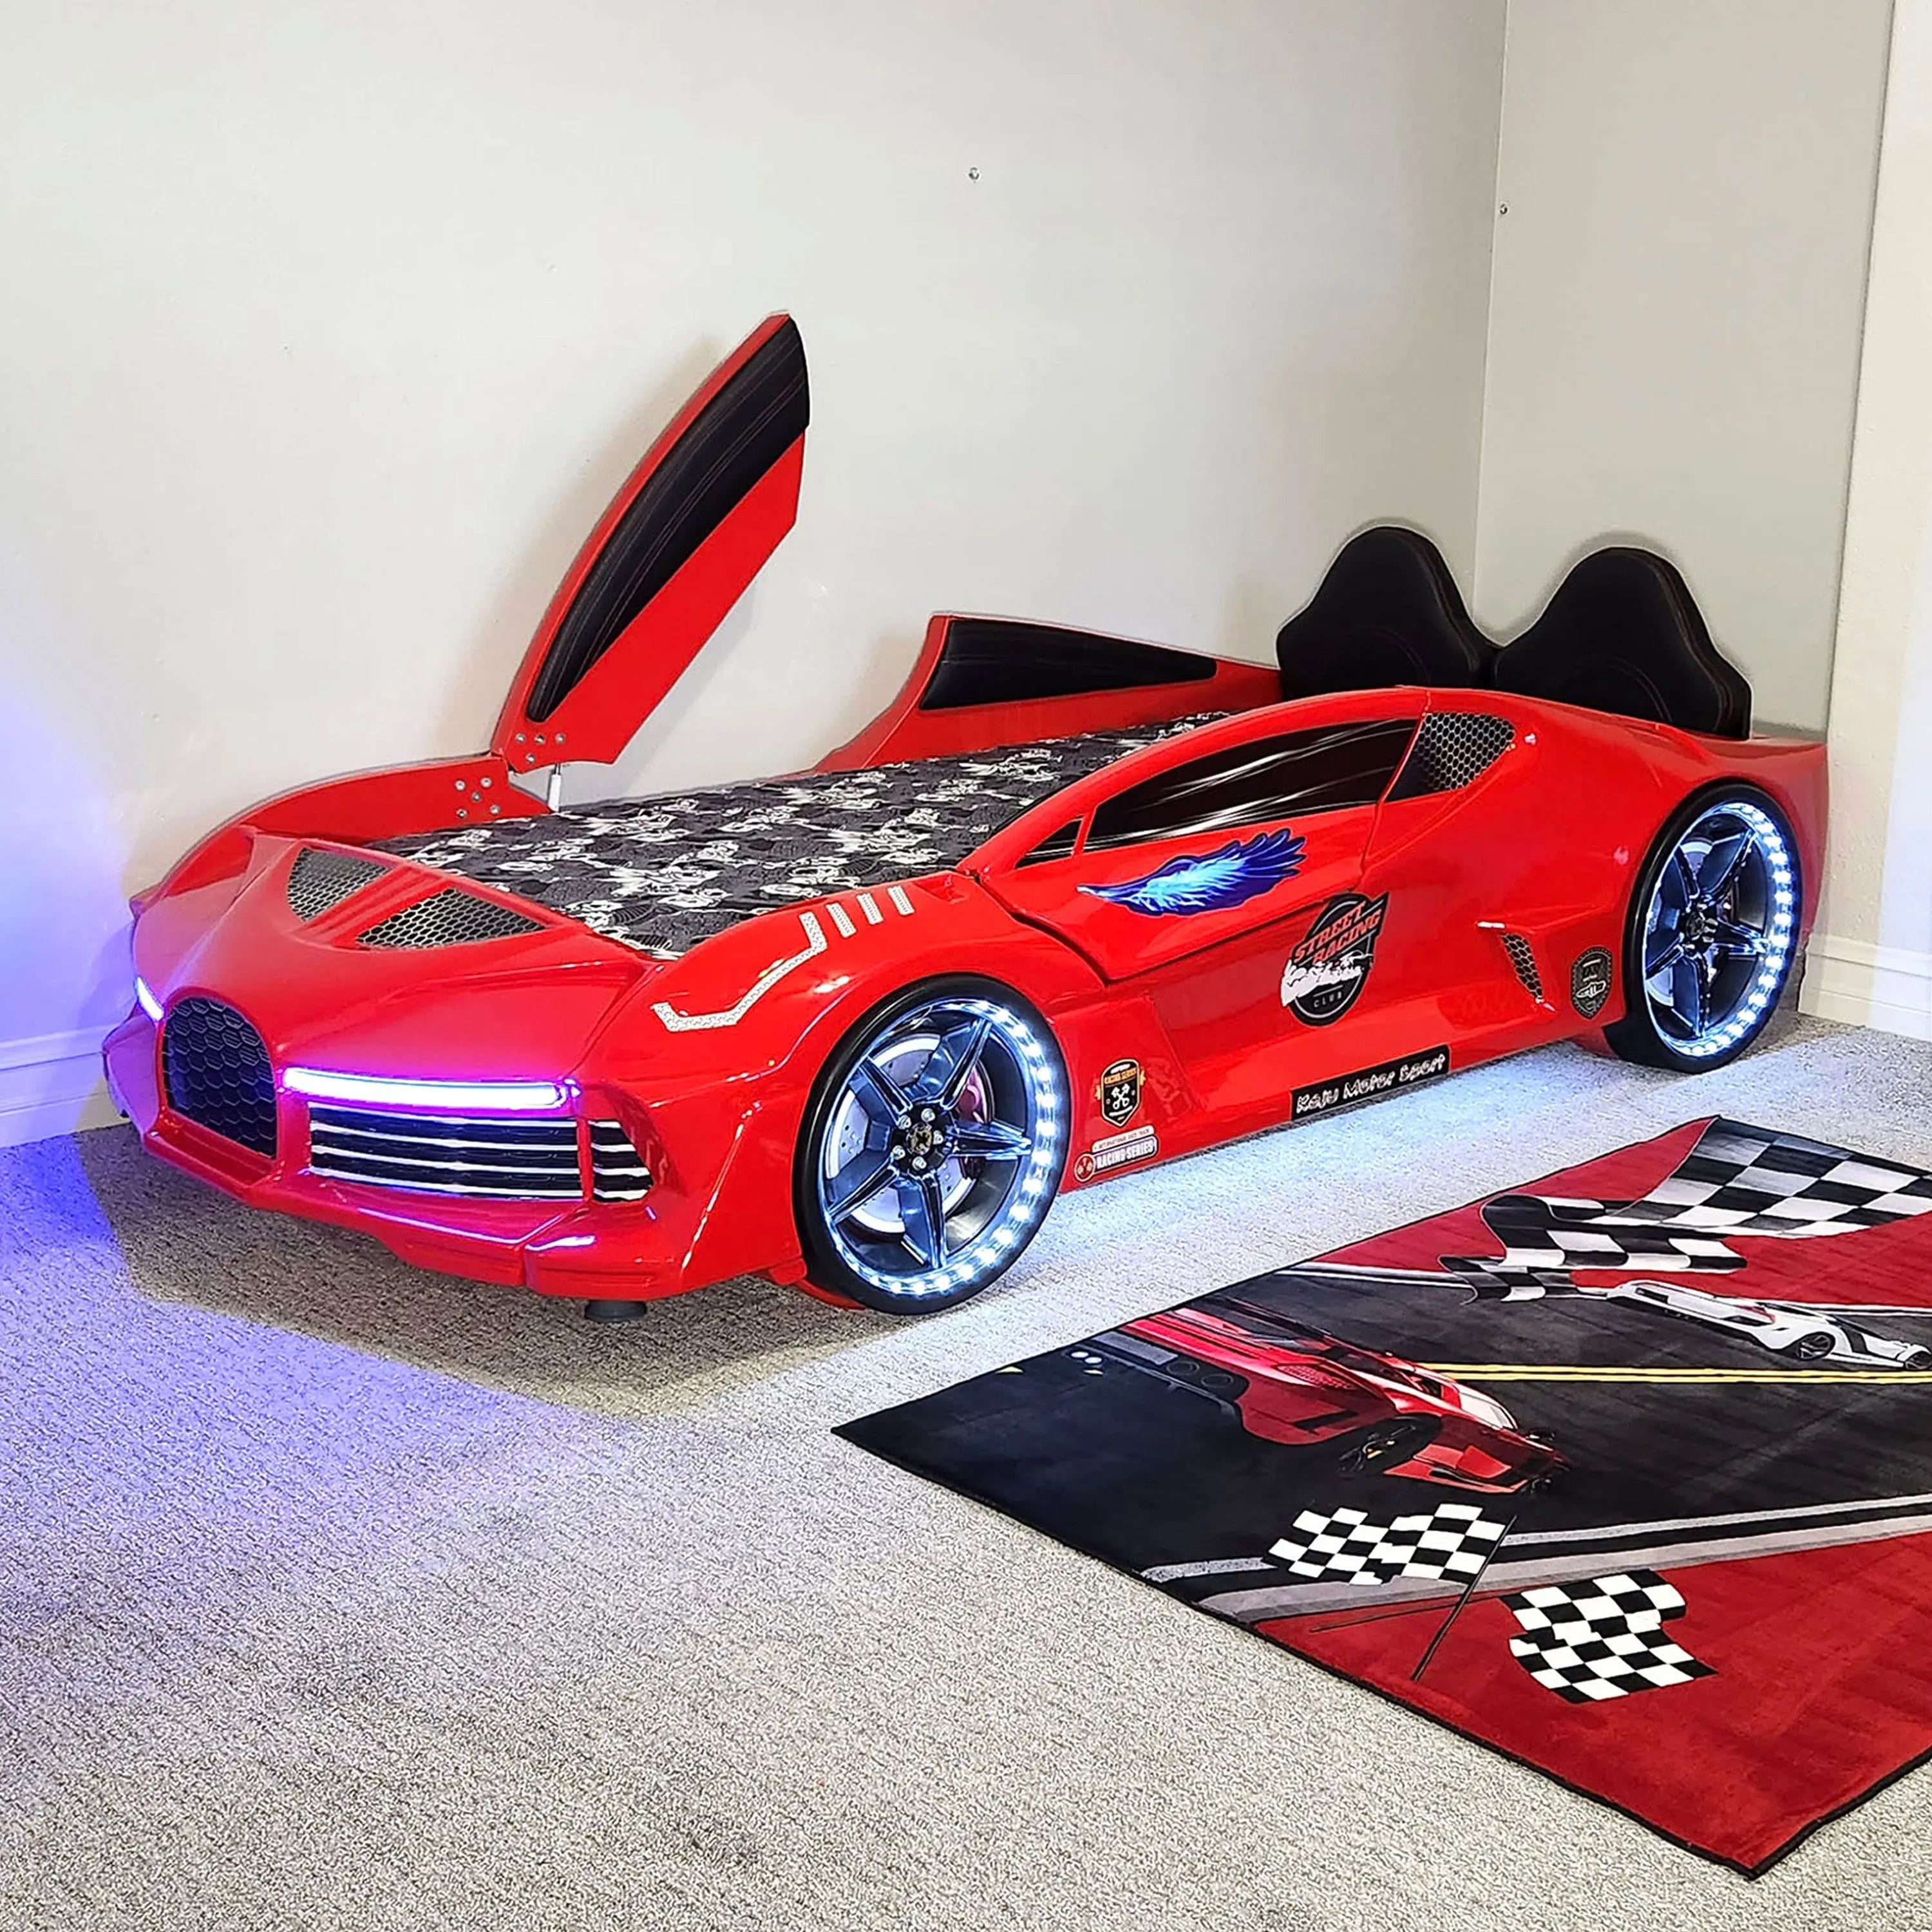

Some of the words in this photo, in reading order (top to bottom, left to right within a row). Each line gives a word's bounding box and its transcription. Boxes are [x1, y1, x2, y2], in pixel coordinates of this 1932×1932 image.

[1294, 901, 1366, 964] STREET
[1312, 909, 1383, 967] RACING
[1314, 991, 1343, 1008] CLUB
